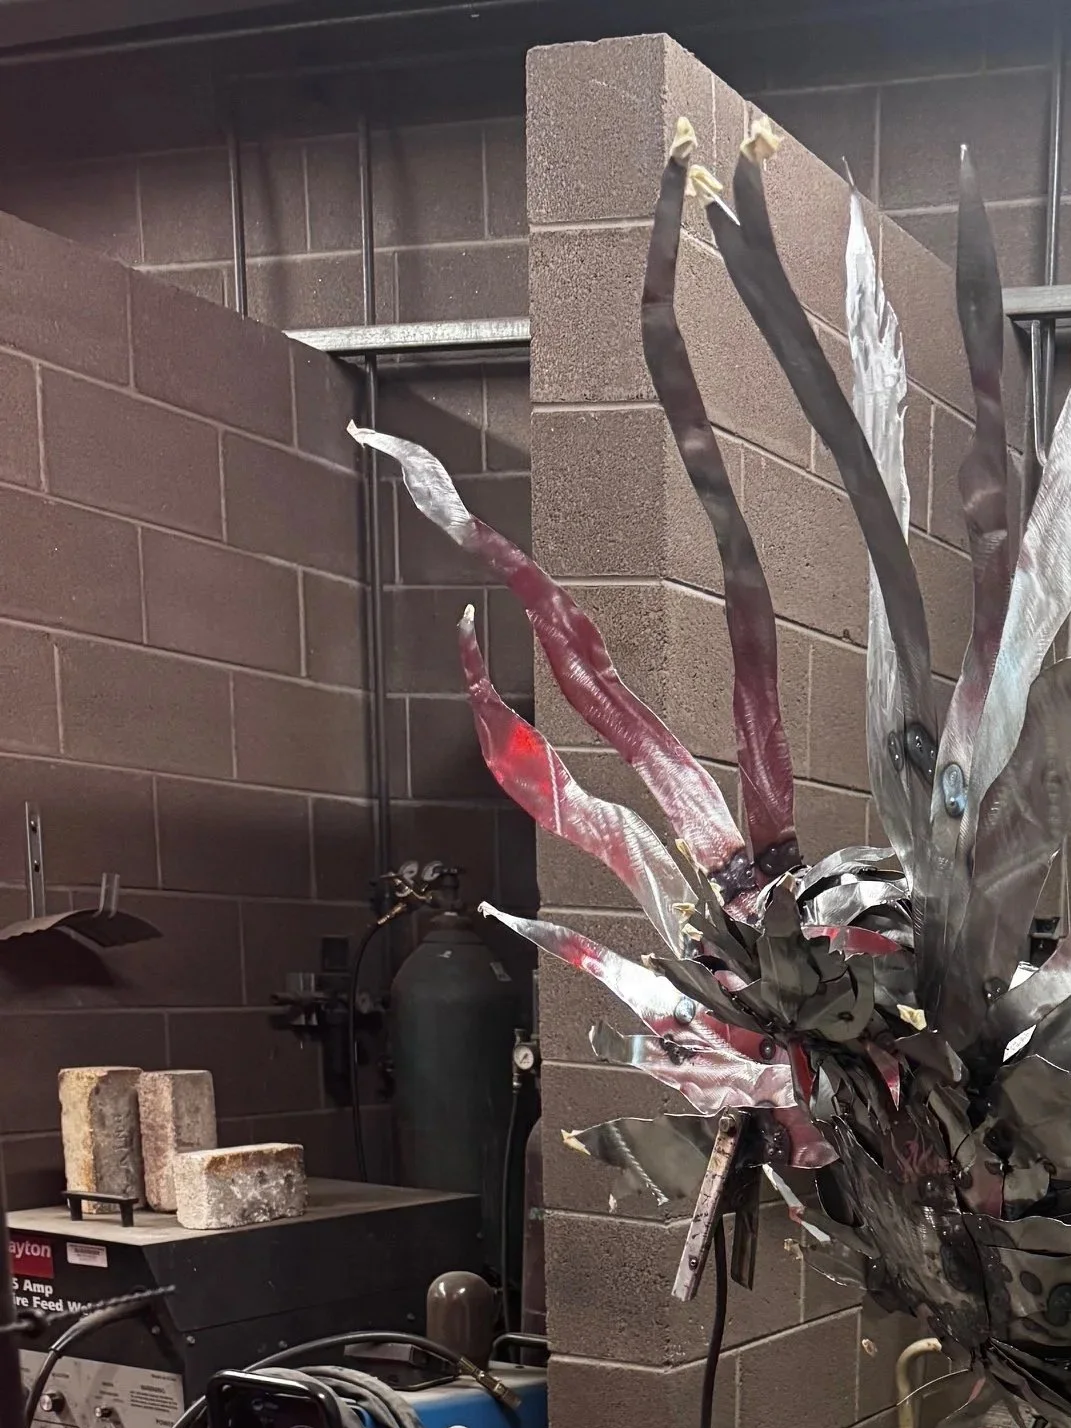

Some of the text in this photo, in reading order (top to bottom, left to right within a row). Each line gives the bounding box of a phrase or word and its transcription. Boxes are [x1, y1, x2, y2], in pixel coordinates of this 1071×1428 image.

[8, 1240, 51, 1258] ayton
[23, 1280, 53, 1297] Amp
[13, 1293, 29, 1307] ire
[33, 1296, 63, 1312] Feed
